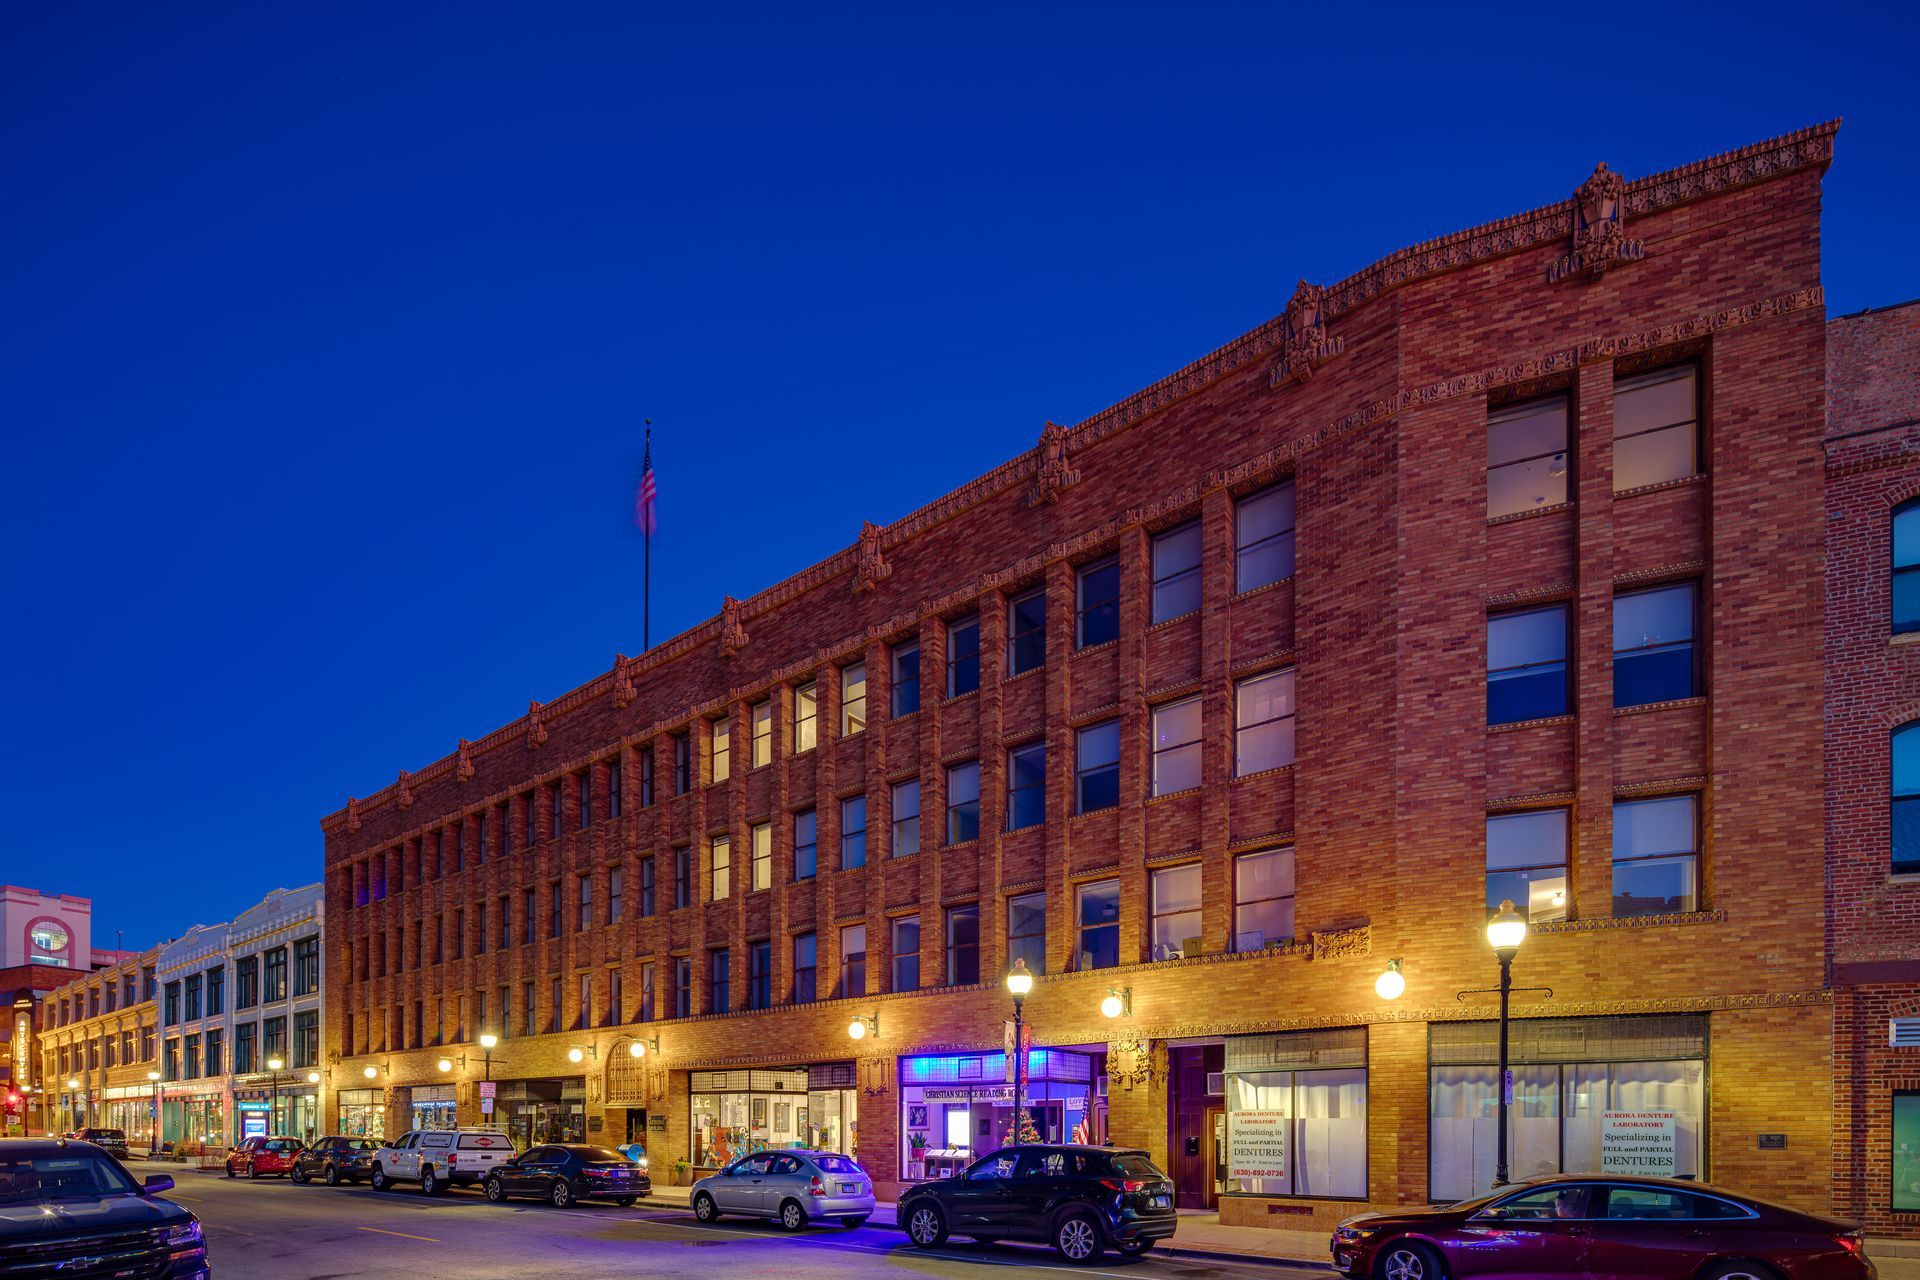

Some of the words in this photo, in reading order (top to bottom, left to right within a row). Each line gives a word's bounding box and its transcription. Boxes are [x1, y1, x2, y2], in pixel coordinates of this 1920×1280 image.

[925, 1088, 954, 1099] CHRISTIAN
[955, 1088, 978, 1098] SCIENCE
[980, 1088, 1007, 1098] READING
[1008, 1088, 1026, 1098] ROM
[1605, 1133, 1660, 1143] Specializing
[1234, 1148, 1284, 1156] DENTURES
[1604, 1156, 1673, 1166] DENTURES
